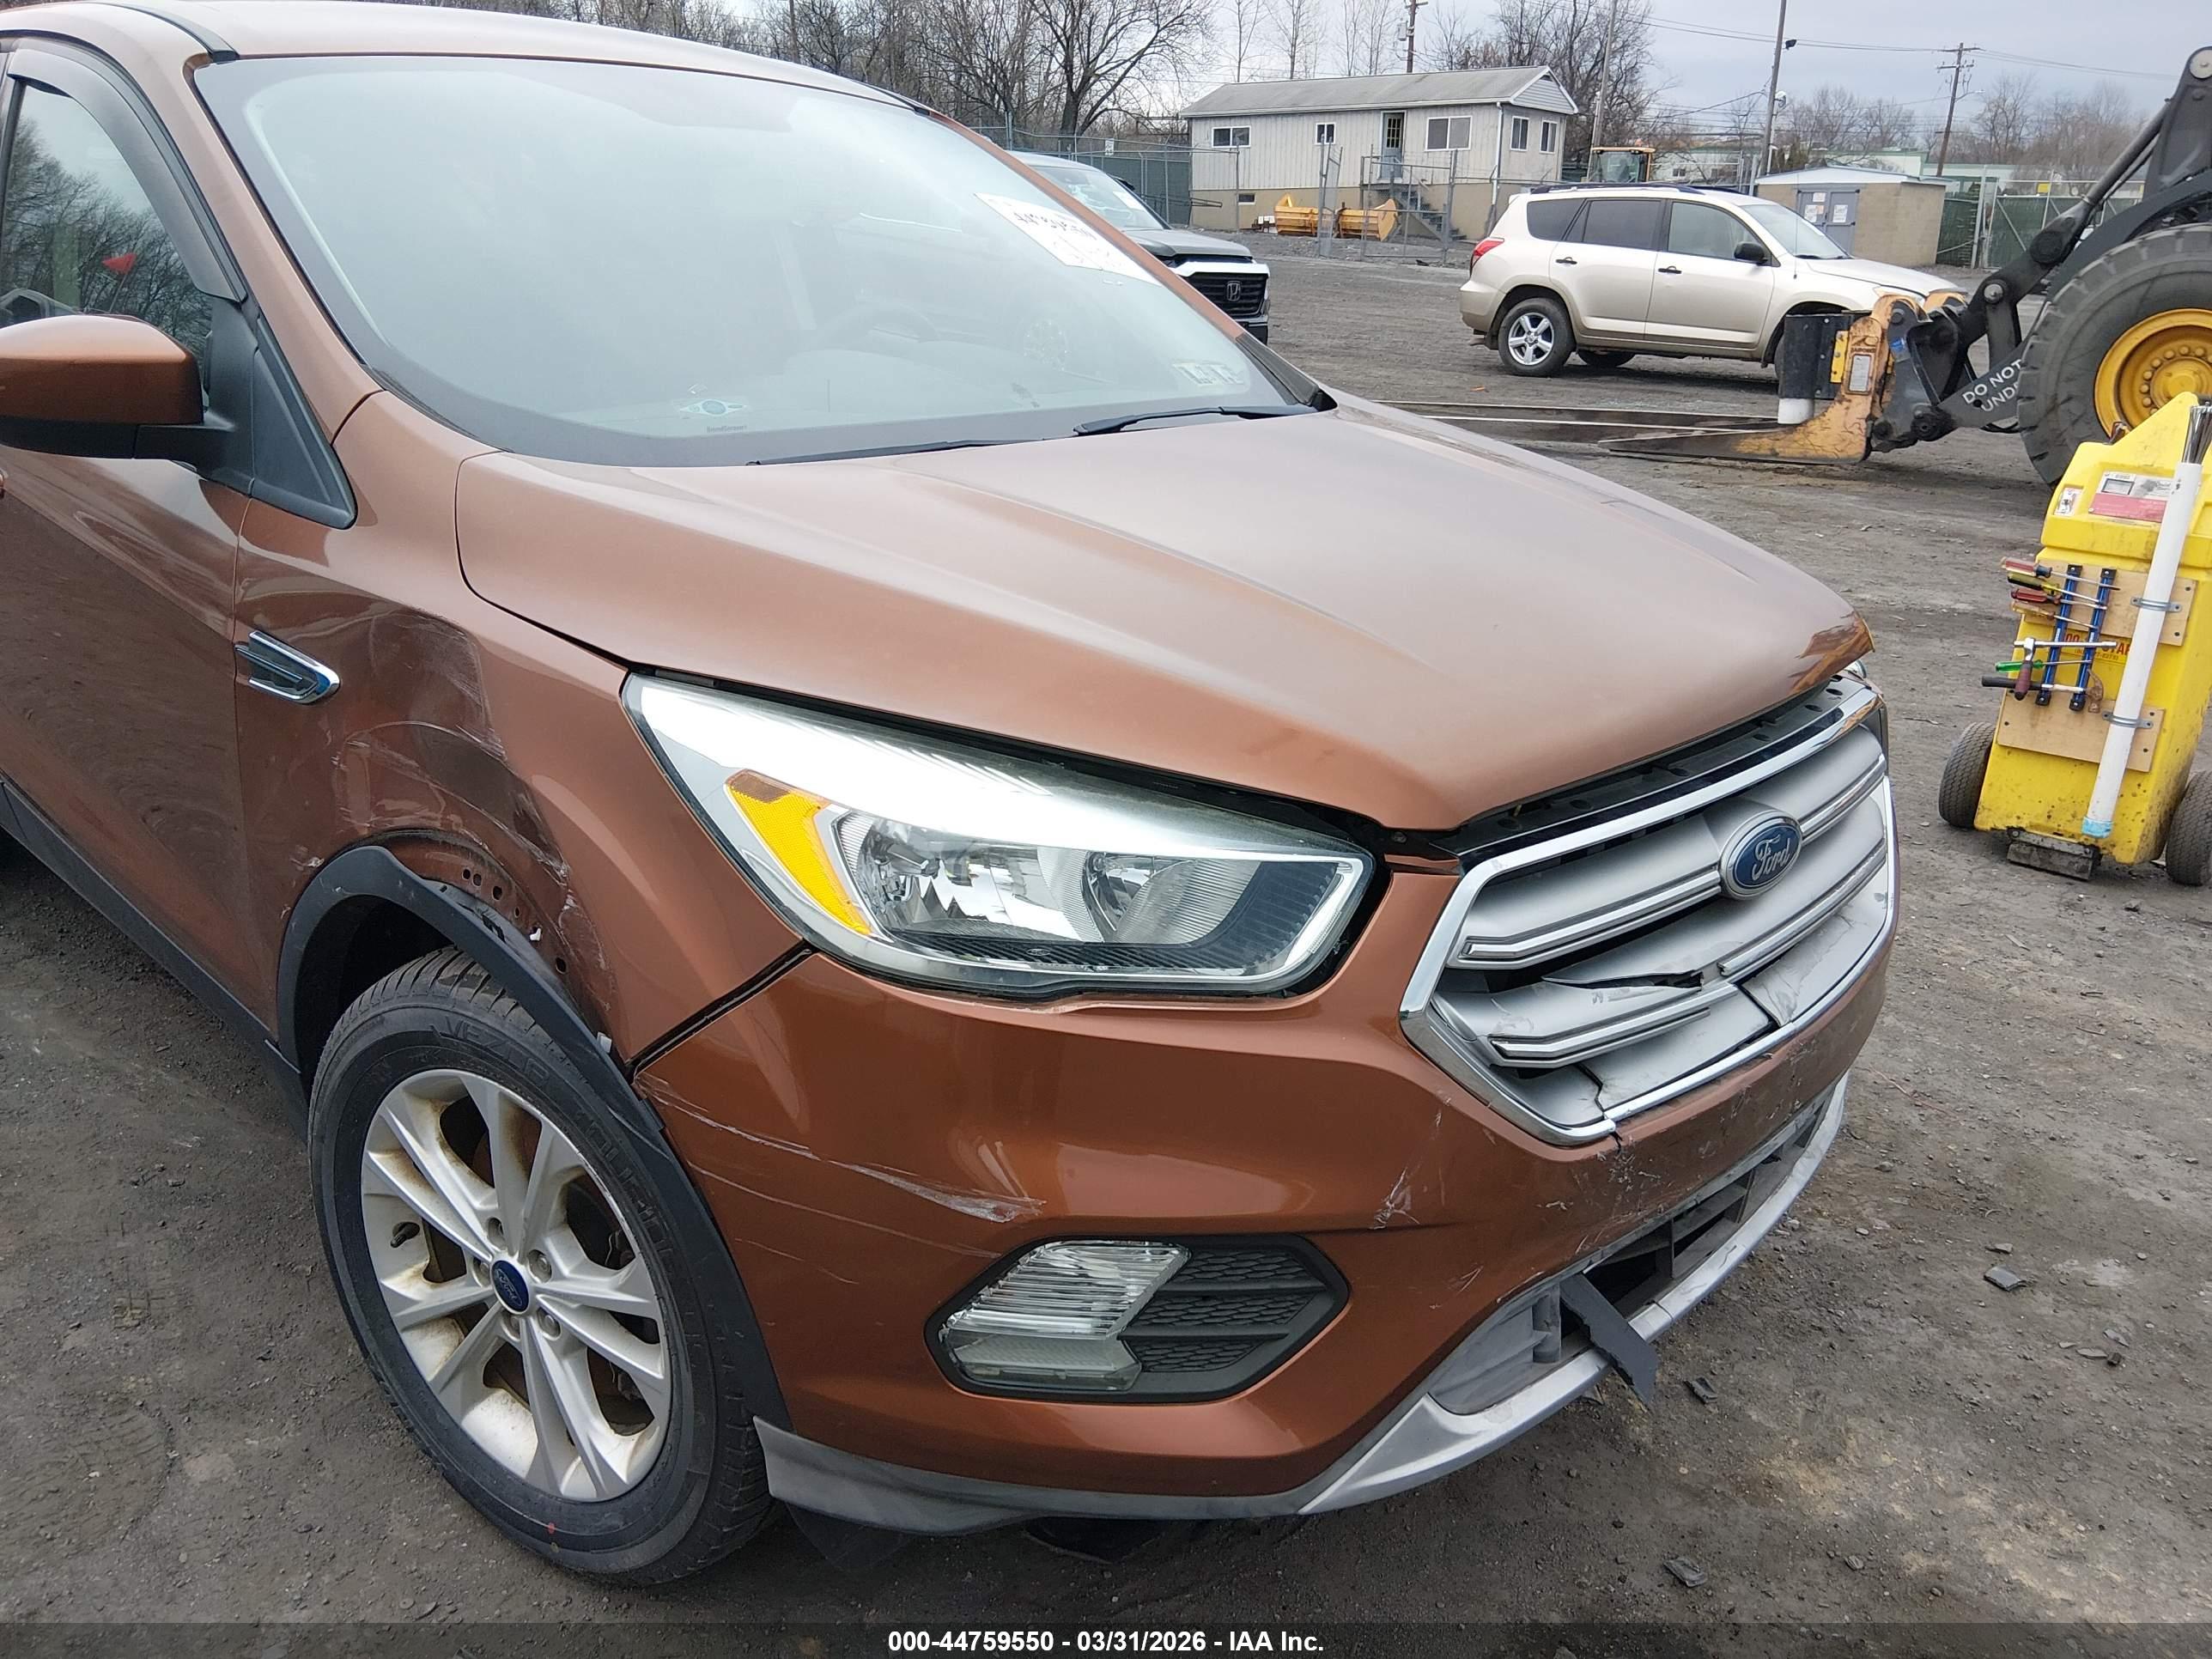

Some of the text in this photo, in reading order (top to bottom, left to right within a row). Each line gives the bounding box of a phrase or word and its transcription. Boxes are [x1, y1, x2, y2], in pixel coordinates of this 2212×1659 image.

[1962, 359, 2022, 404] DO NOT
[1751, 834, 1791, 881] Ford
